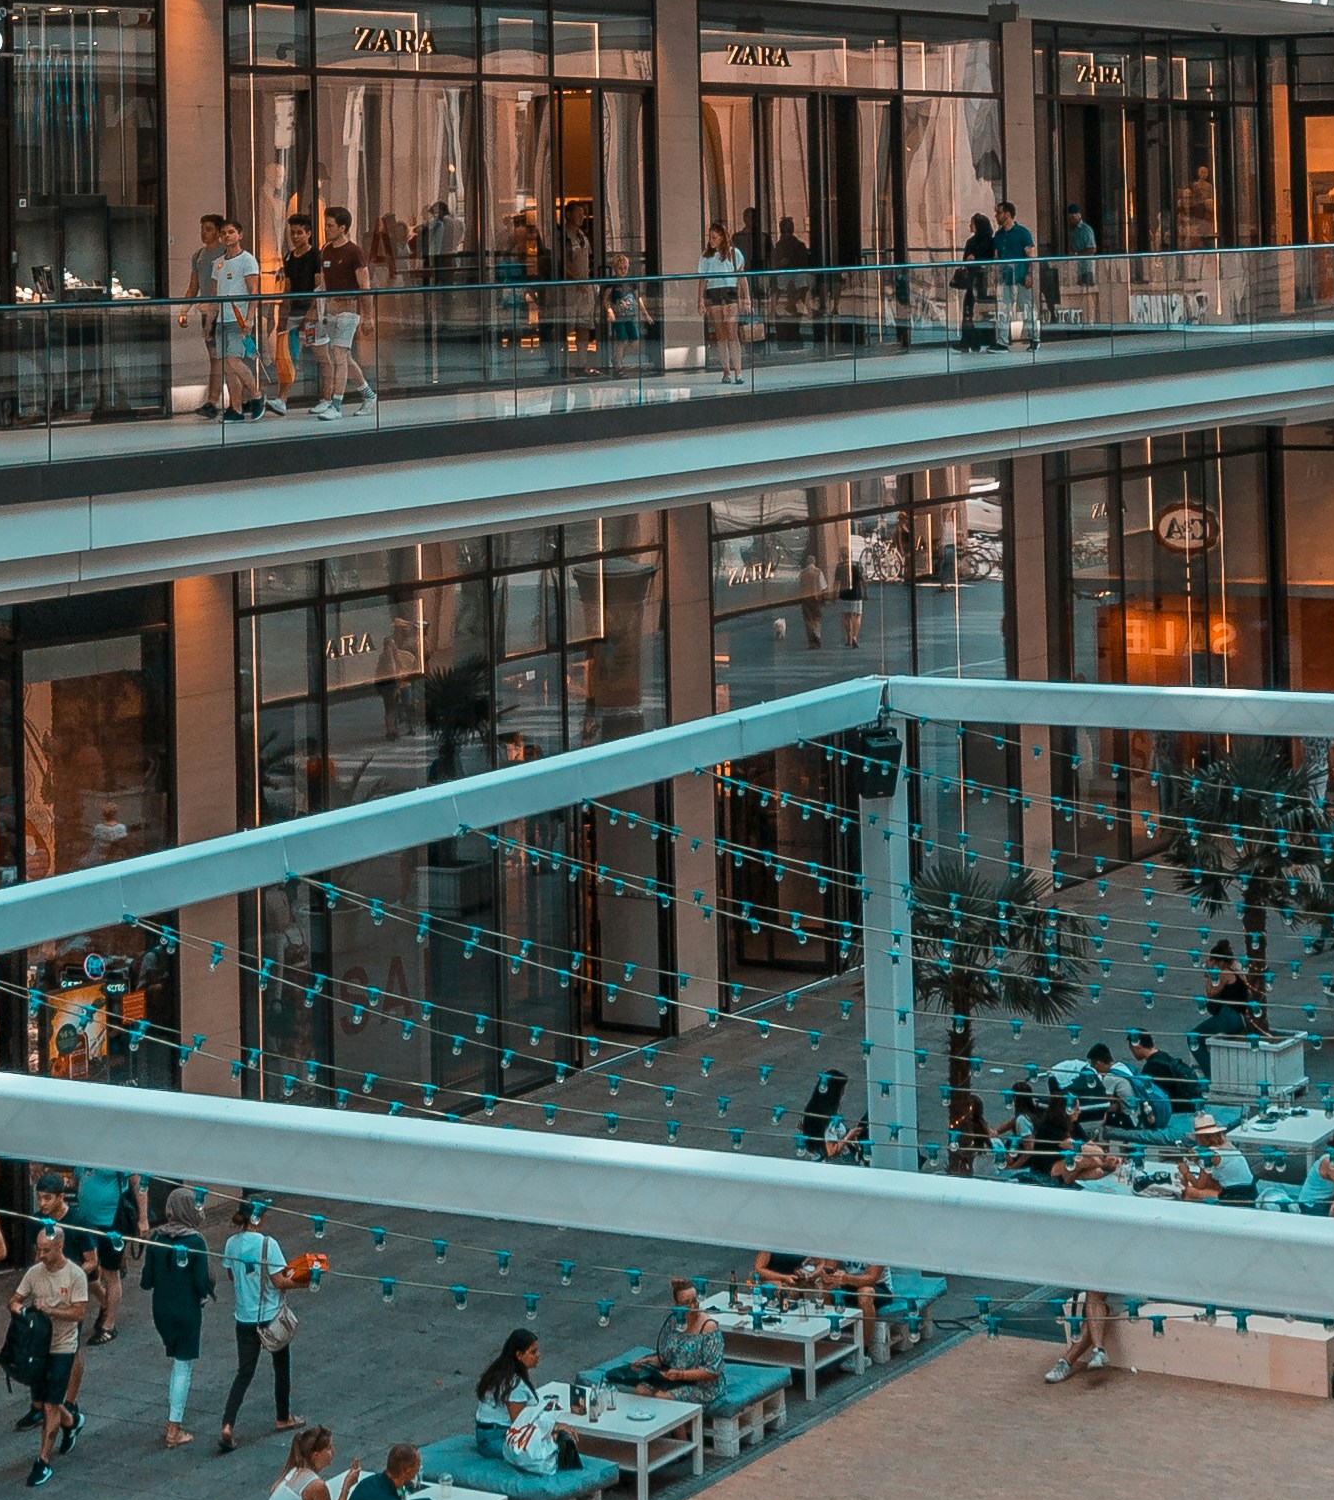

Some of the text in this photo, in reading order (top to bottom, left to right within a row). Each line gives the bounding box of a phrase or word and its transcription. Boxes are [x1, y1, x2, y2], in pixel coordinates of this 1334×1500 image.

[354, 26, 437, 54] ZARA
[727, 44, 793, 67] ZARA
[1076, 63, 1126, 84] ZARA
[728, 561, 775, 587] ZARA
[325, 631, 376, 660] ARA
